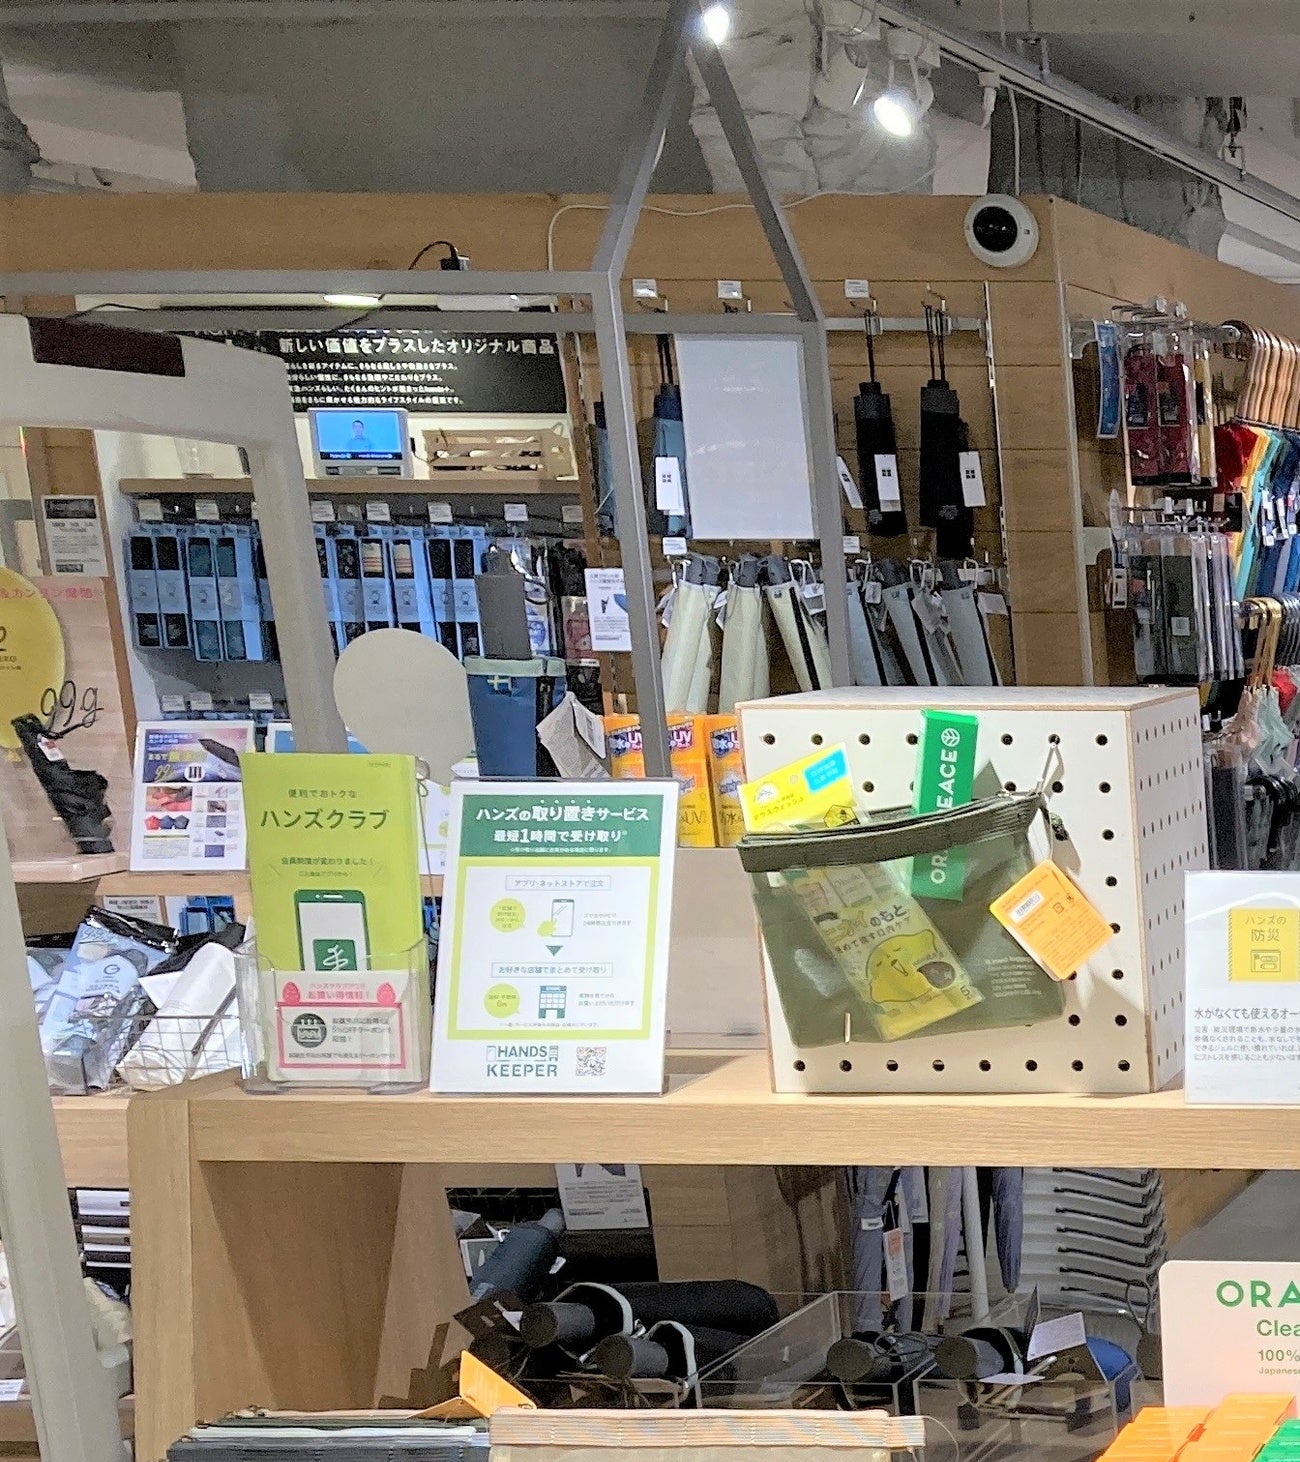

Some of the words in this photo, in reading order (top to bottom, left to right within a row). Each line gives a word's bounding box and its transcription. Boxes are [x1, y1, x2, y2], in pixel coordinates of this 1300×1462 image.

[289, 789, 356, 798] 便利でおトクな
[261, 809, 389, 829] ハンズクラブ
[476, 806, 649, 821] ハンズの取り置きサービス
[1245, 915, 1286, 925] ハンズの
[1251, 929, 1279, 941] 防災
[498, 1046, 547, 1058] HANDS
[488, 1064, 557, 1076] KEEPER
[1258, 1349, 1300, 1363] 100%
